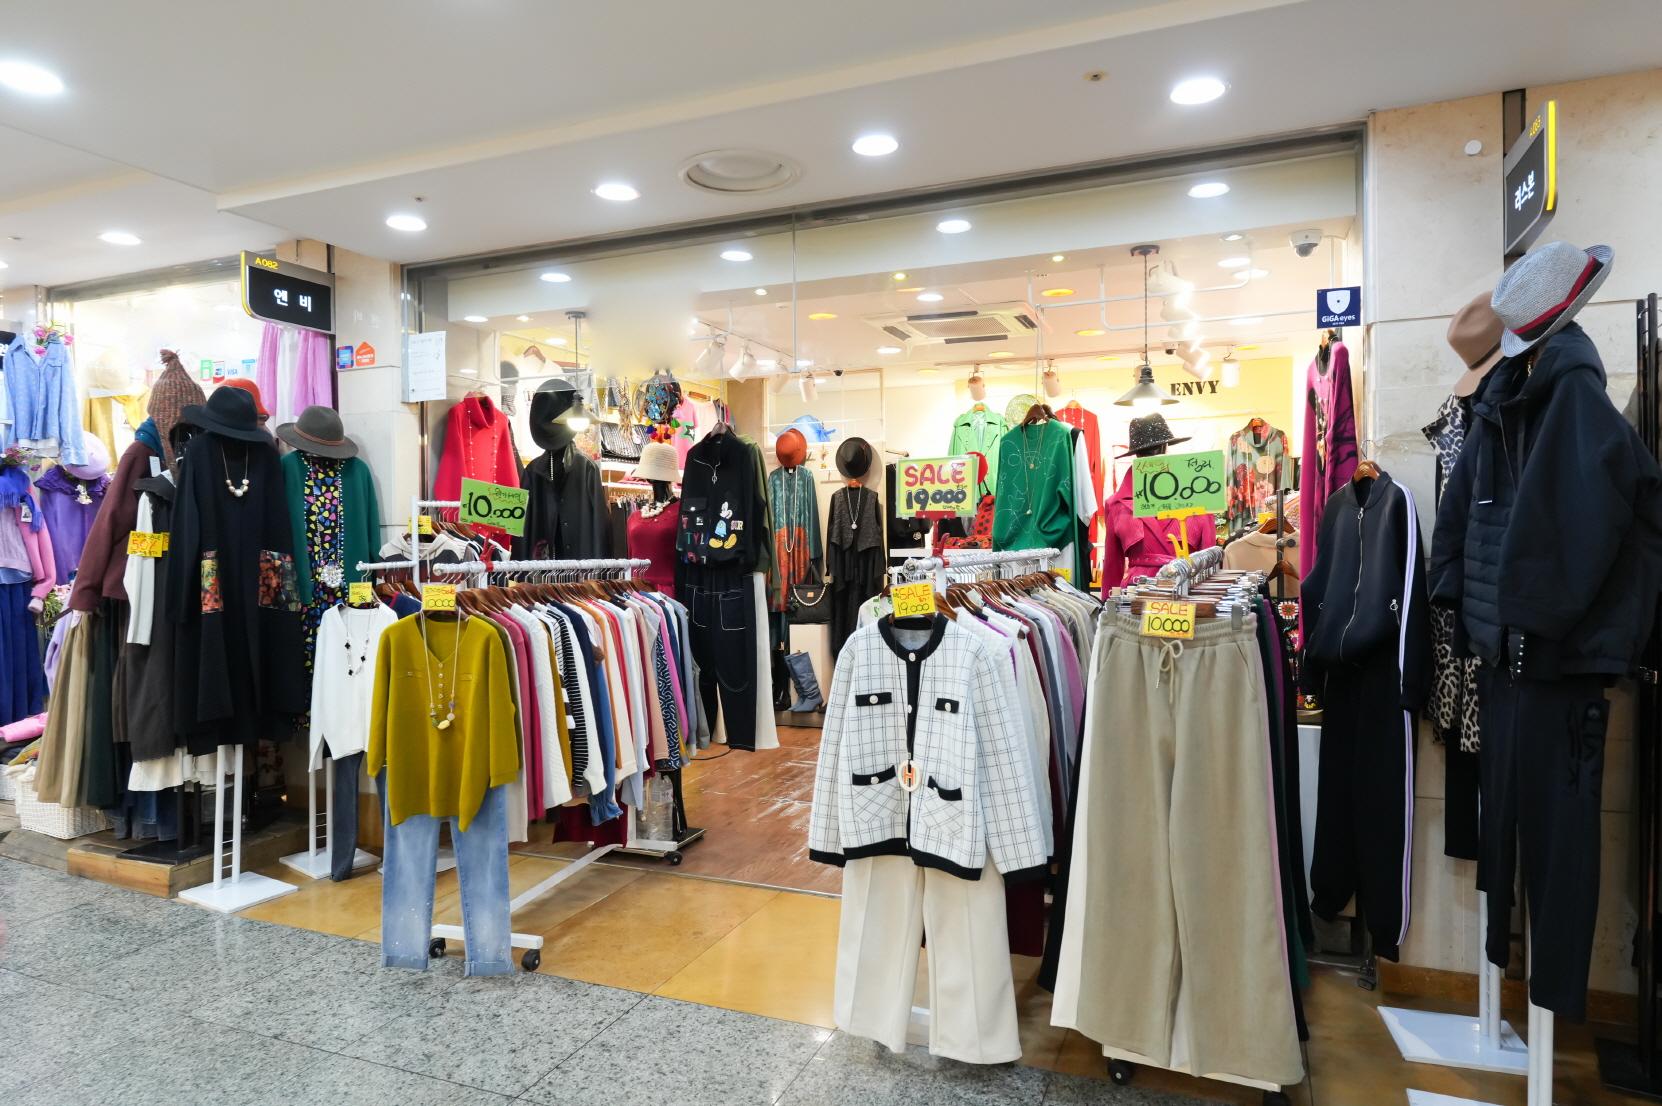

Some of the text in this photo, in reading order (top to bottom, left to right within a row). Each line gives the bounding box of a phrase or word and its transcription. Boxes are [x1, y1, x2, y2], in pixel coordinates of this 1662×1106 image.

[255, 257, 279, 270] A082
[1340, 314, 1356, 322] eyes
[1170, 380, 1220, 396] ENVY
[904, 462, 966, 488] SALE
[899, 584, 931, 601] SALE
[1151, 601, 1188, 616] SALE
[1147, 615, 1190, 633] 10000
